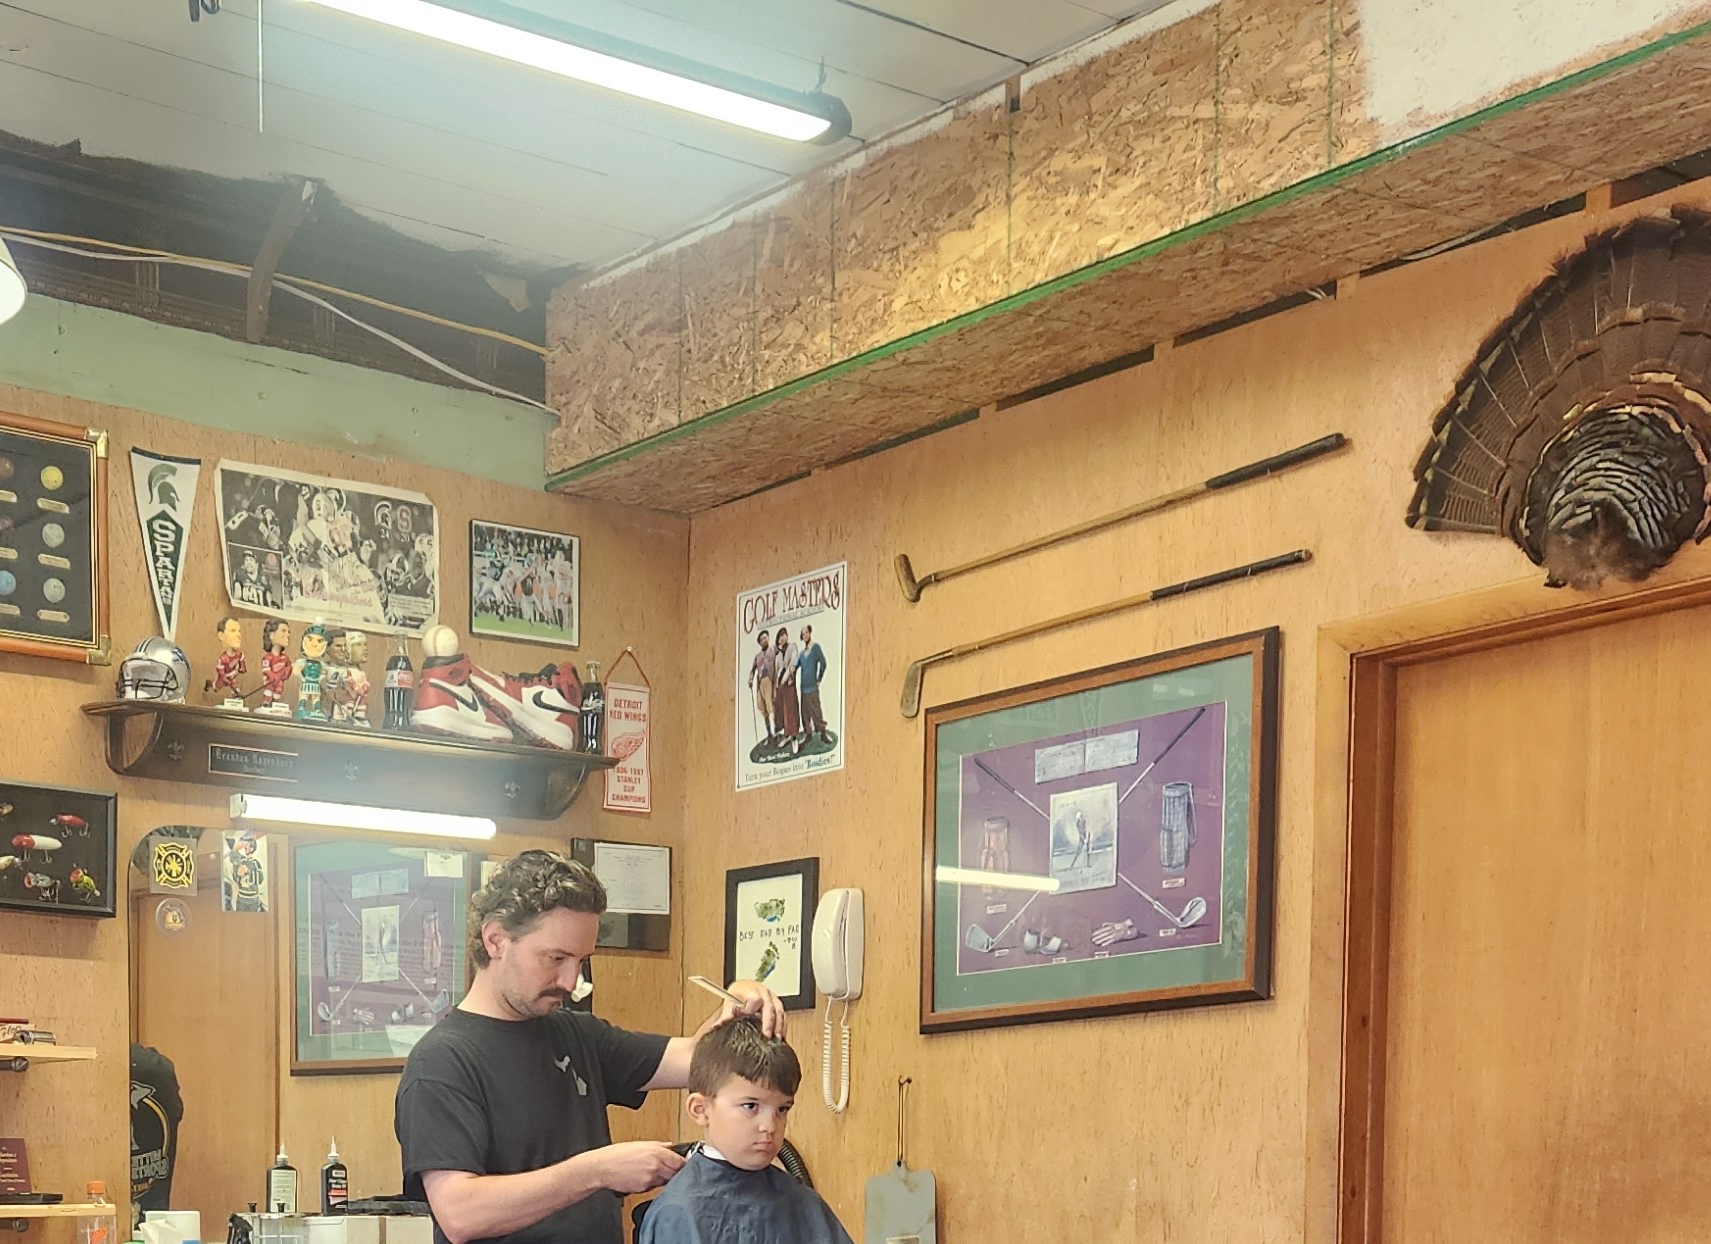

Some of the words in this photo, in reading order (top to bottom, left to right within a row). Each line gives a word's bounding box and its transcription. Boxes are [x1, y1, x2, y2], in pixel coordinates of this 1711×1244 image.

[743, 589, 778, 634] GOLF
[782, 570, 840, 613] MASTERS
[613, 698, 643, 710] DETROIT
[610, 709, 623, 720] RED
[624, 711, 647, 723] WINGS
[616, 775, 641, 784] STANLEY
[623, 784, 635, 793] CUP
[611, 793, 646, 803] CHAMPIONS
[739, 930, 755, 941] BEST
[776, 926, 785, 936] BY
